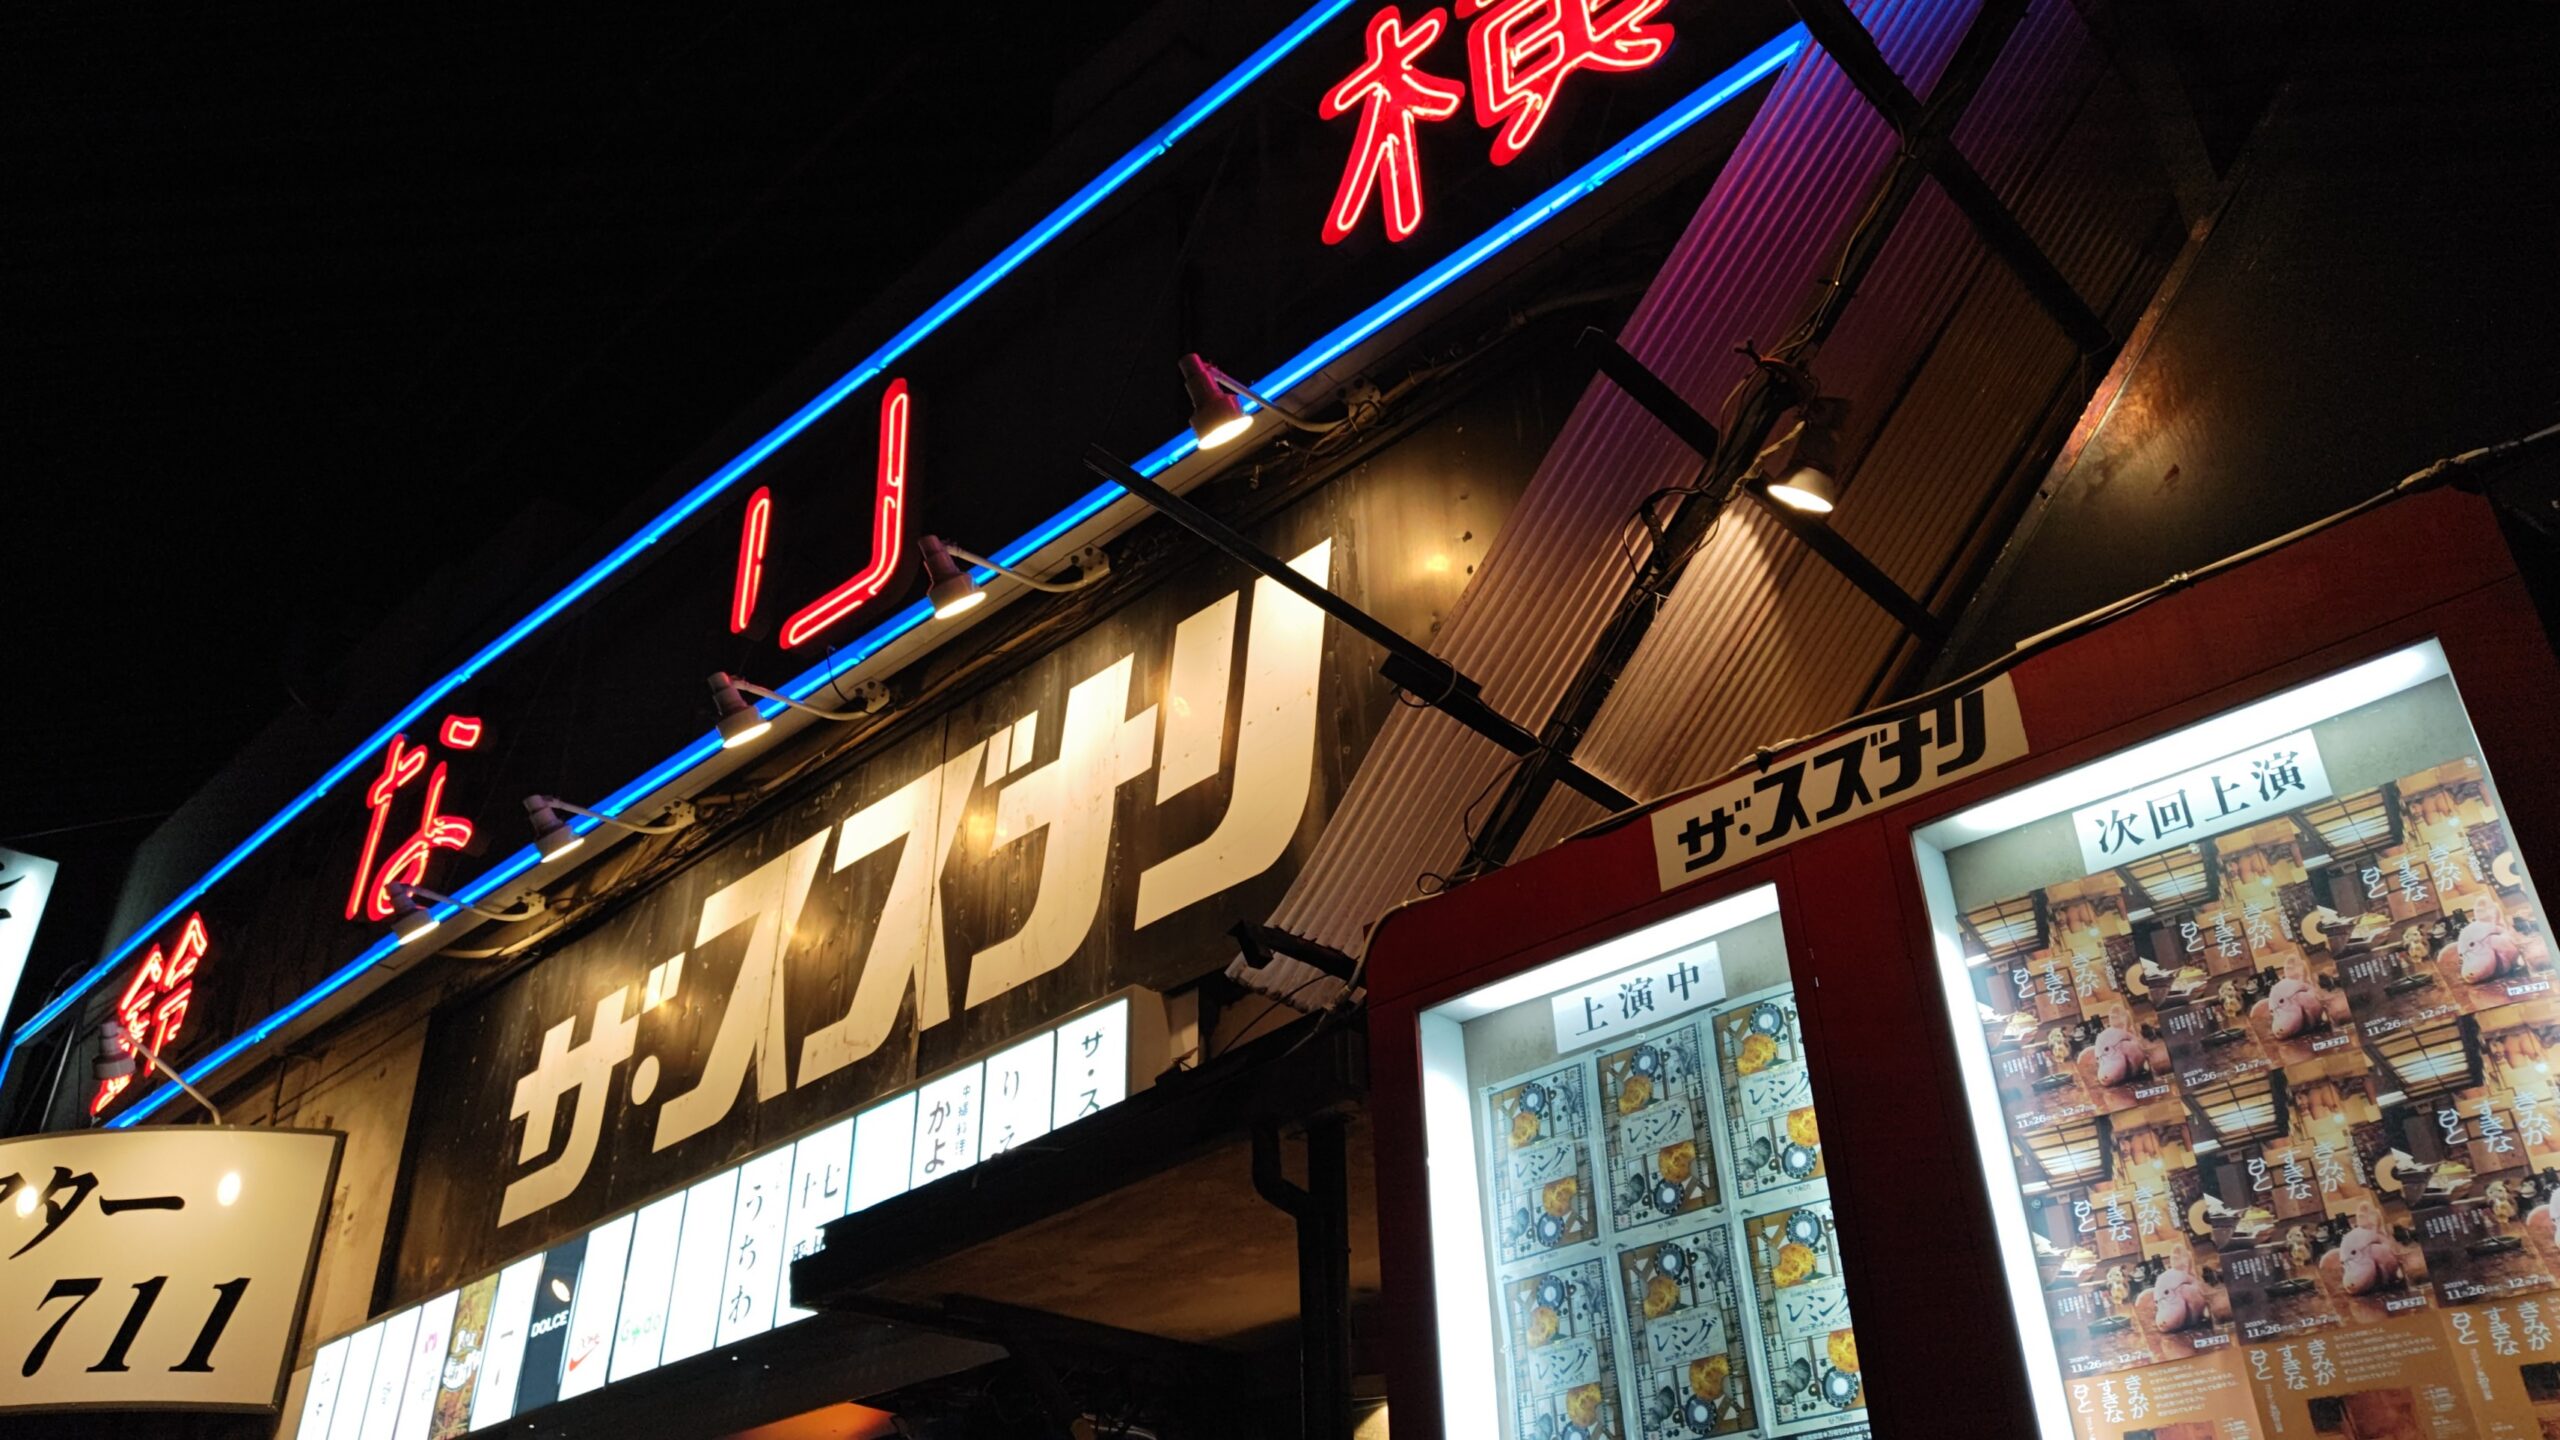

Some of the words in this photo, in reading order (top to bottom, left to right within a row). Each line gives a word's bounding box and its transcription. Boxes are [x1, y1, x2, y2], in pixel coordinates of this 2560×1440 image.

[1678, 688, 1987, 873] ザ・スズナリ
[2095, 751, 2306, 855] 次回上演
[497, 537, 1333, 1228] ザ・スズナリ
[2361, 866, 2389, 899] ひと
[2392, 854, 2430, 902] すきな
[2427, 843, 2462, 892] きみが
[2180, 921, 2205, 952] ひと
[2208, 911, 2242, 958] すきな
[2243, 903, 2273, 949] きみが
[2012, 968, 2036, 999] ひと
[2039, 960, 2070, 1005] すきな
[2071, 953, 2099, 997] きみが
[1576, 962, 1699, 1036] 上演中
[925, 1101, 951, 1174] かよ
[1627, 1107, 1686, 1143] レミング
[2437, 1109, 2469, 1146] ひと
[2472, 1101, 2515, 1154] すきな
[2513, 1091, 2553, 1147] きみが
[1515, 1144, 1571, 1179] レミング
[2247, 1157, 2273, 1192] ひと
[2277, 1150, 2312, 1200] すきな
[2312, 1140, 2345, 1194] きみが
[2074, 1200, 2096, 1233] ひと
[2102, 1191, 2132, 1241] すきな
[2134, 1186, 2163, 1236] きみが
[729, 1185, 762, 1324] うちわ
[22, 1276, 251, 1377] 711
[530, 1309, 569, 1338] DOLCE
[1654, 1317, 1718, 1352] レミング
[2451, 1311, 2480, 1345] ひと
[2482, 1306, 2520, 1356] すきな
[2517, 1301, 2553, 1351] きみが
[1536, 1346, 1593, 1380] レミング
[2249, 1349, 2273, 1381] ひと
[2276, 1344, 2309, 1391] すきな
[2307, 1338, 2337, 1387] きみが
[2073, 1383, 2095, 1414] ひと
[2096, 1378, 2125, 1424] すきな
[2124, 1374, 2150, 1420] きみが
